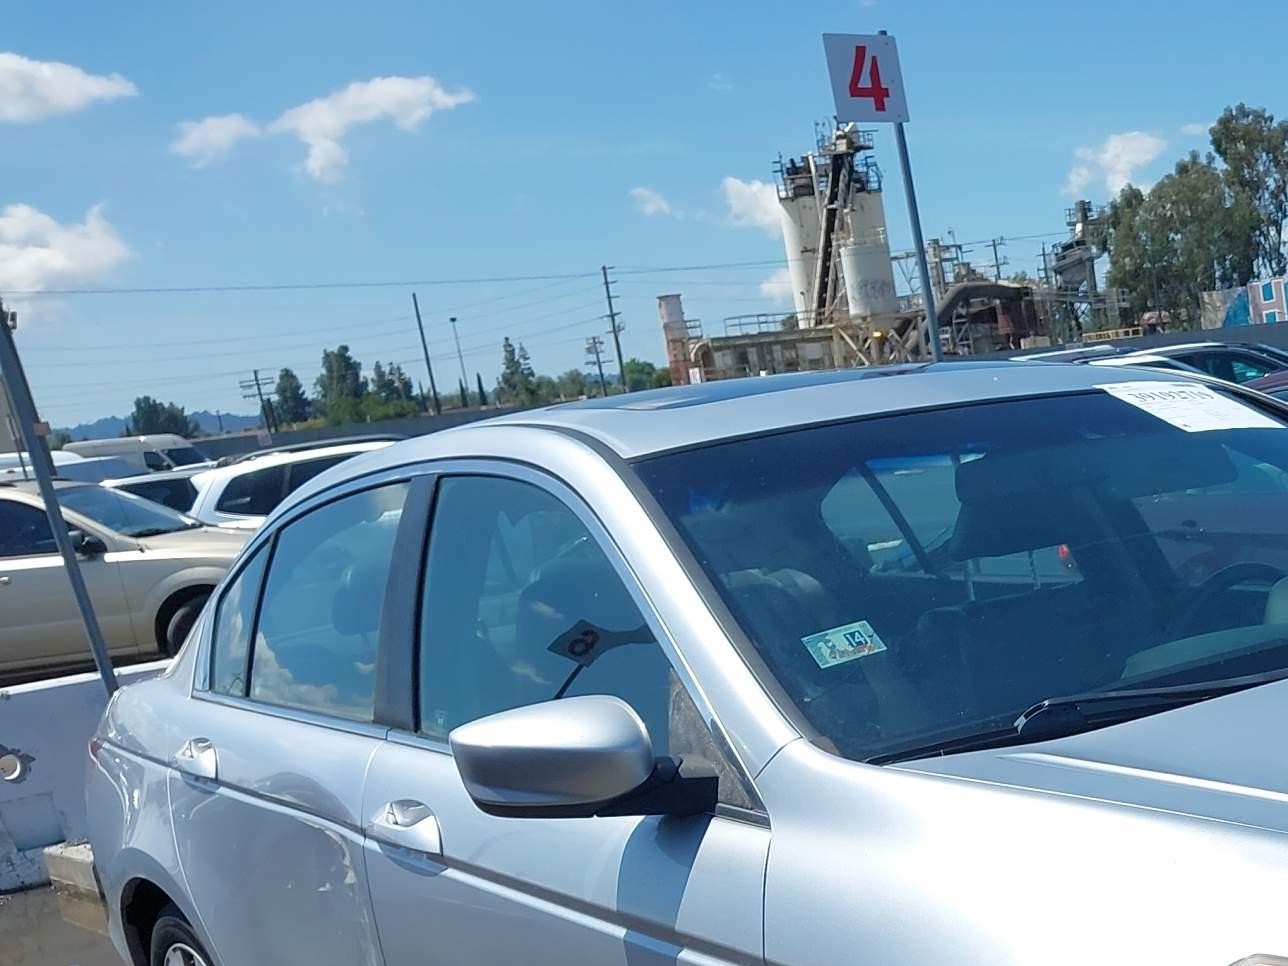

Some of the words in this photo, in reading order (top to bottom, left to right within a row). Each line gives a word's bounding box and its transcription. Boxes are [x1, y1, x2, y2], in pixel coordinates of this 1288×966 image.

[848, 45, 891, 112] 4
[1128, 388, 1214, 403] 39192719
[845, 631, 866, 648] 14
